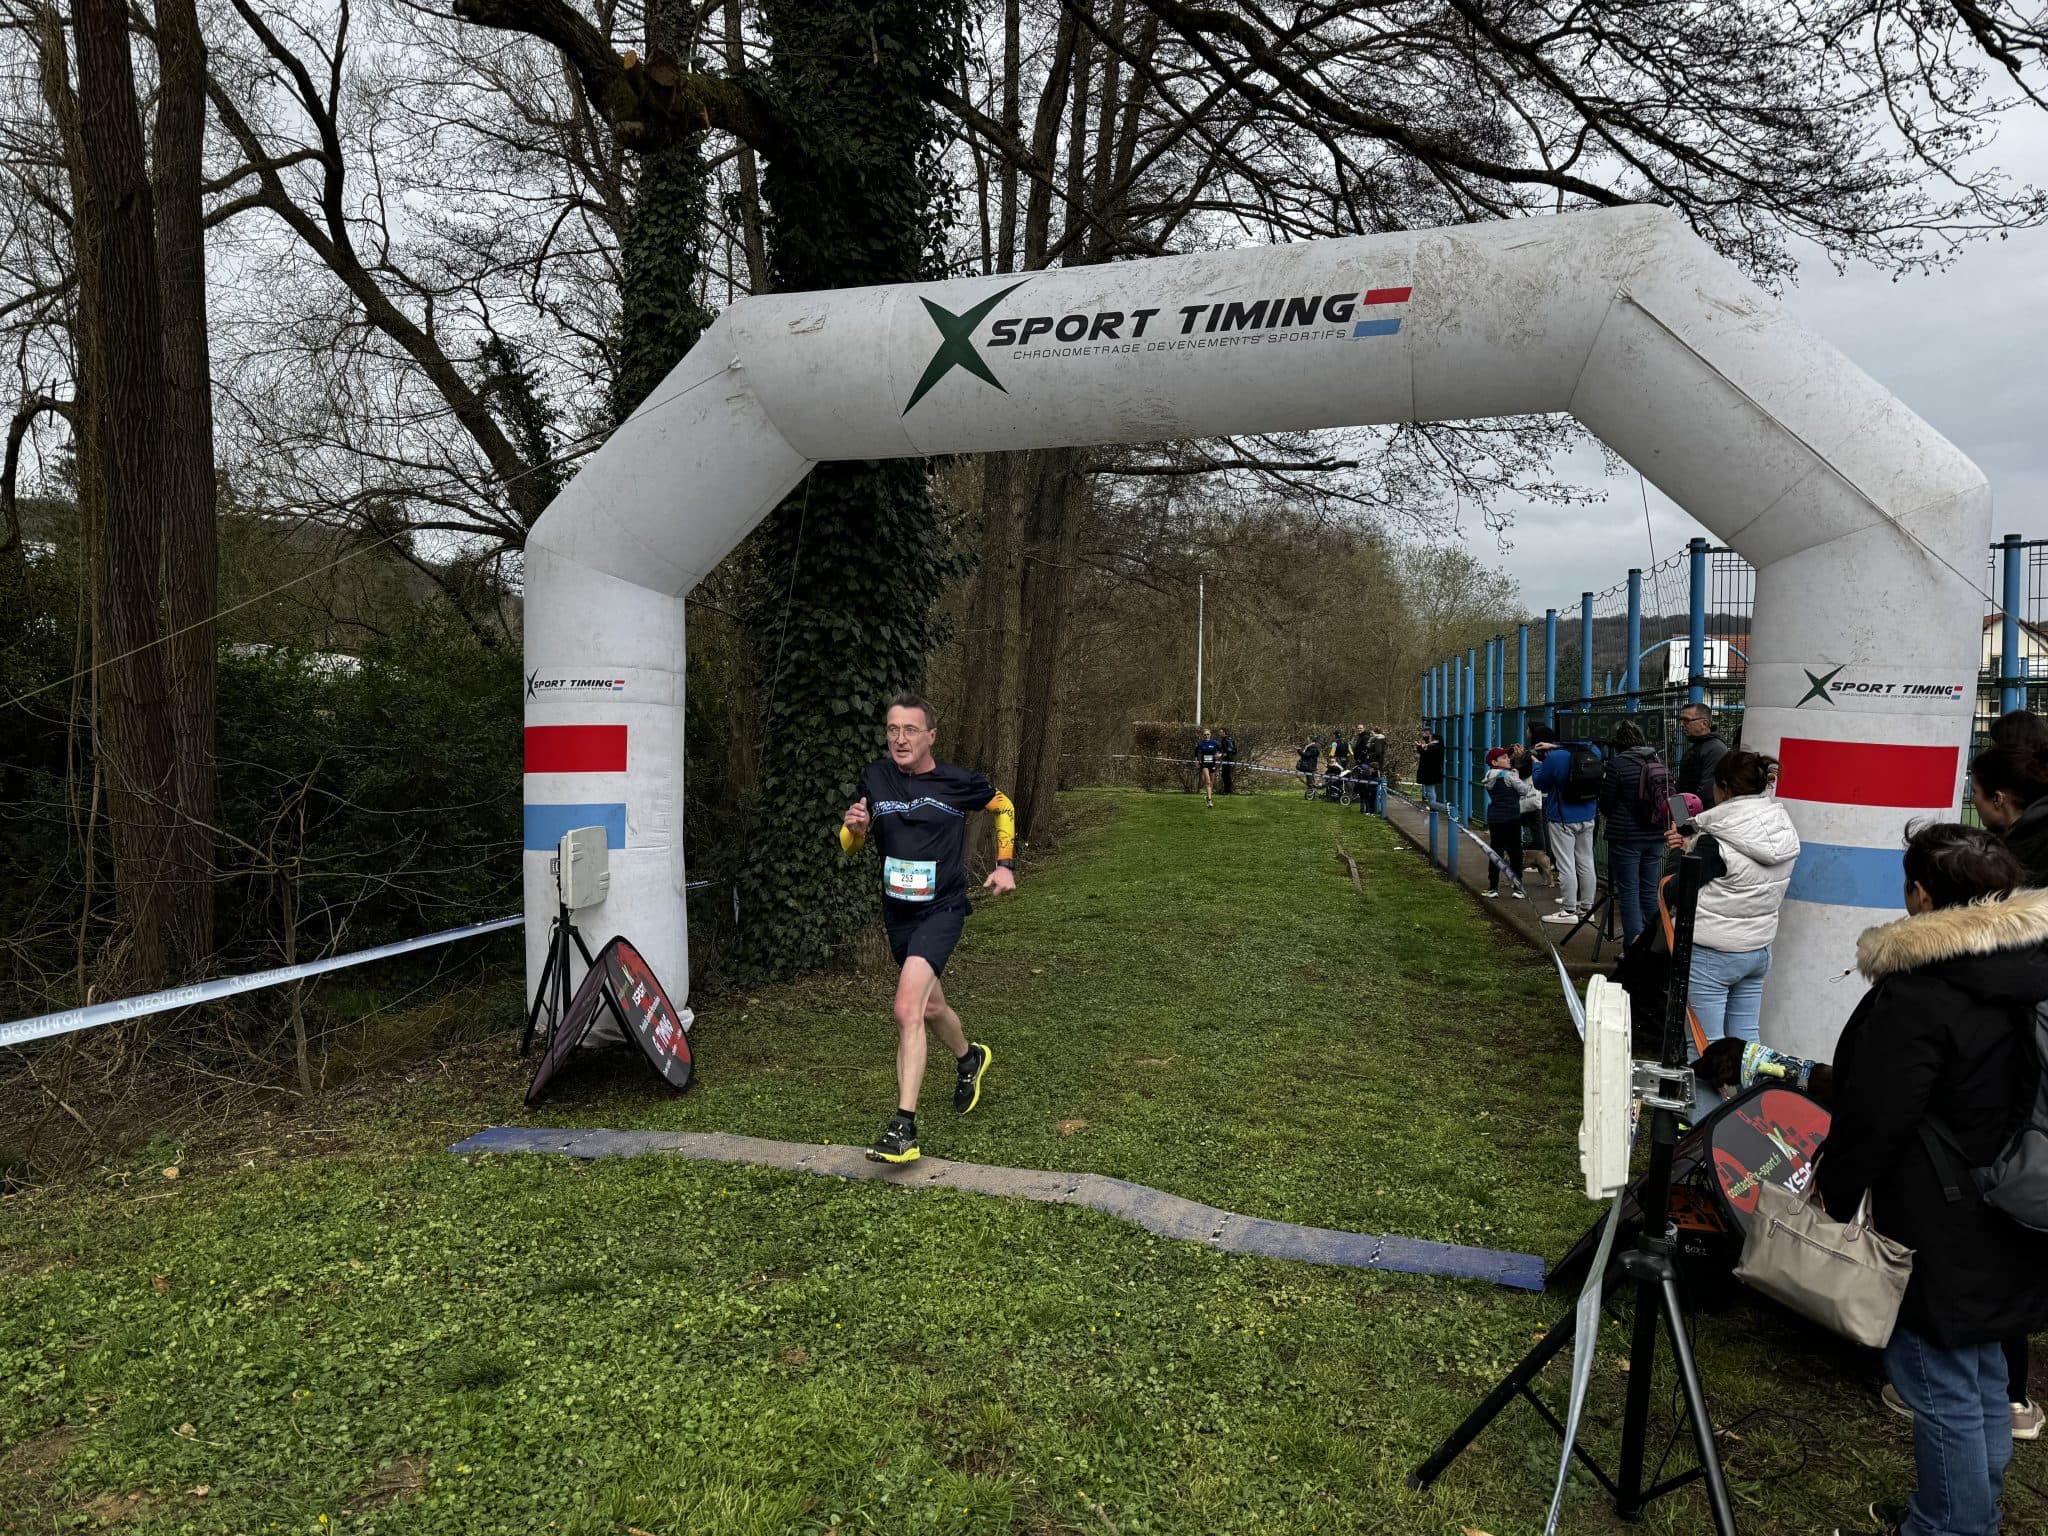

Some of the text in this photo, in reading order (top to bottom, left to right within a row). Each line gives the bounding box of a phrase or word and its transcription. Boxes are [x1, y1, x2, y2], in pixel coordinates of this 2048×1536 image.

[1179, 293, 1359, 334] TIMING
[1013, 329, 1347, 360] CHRONOMETRAGE DEVENEMENTS SPORTIFS
[570, 680, 613, 688] TIMING
[1902, 684, 1953, 695] TIMING
[901, 874, 913, 882] 253
